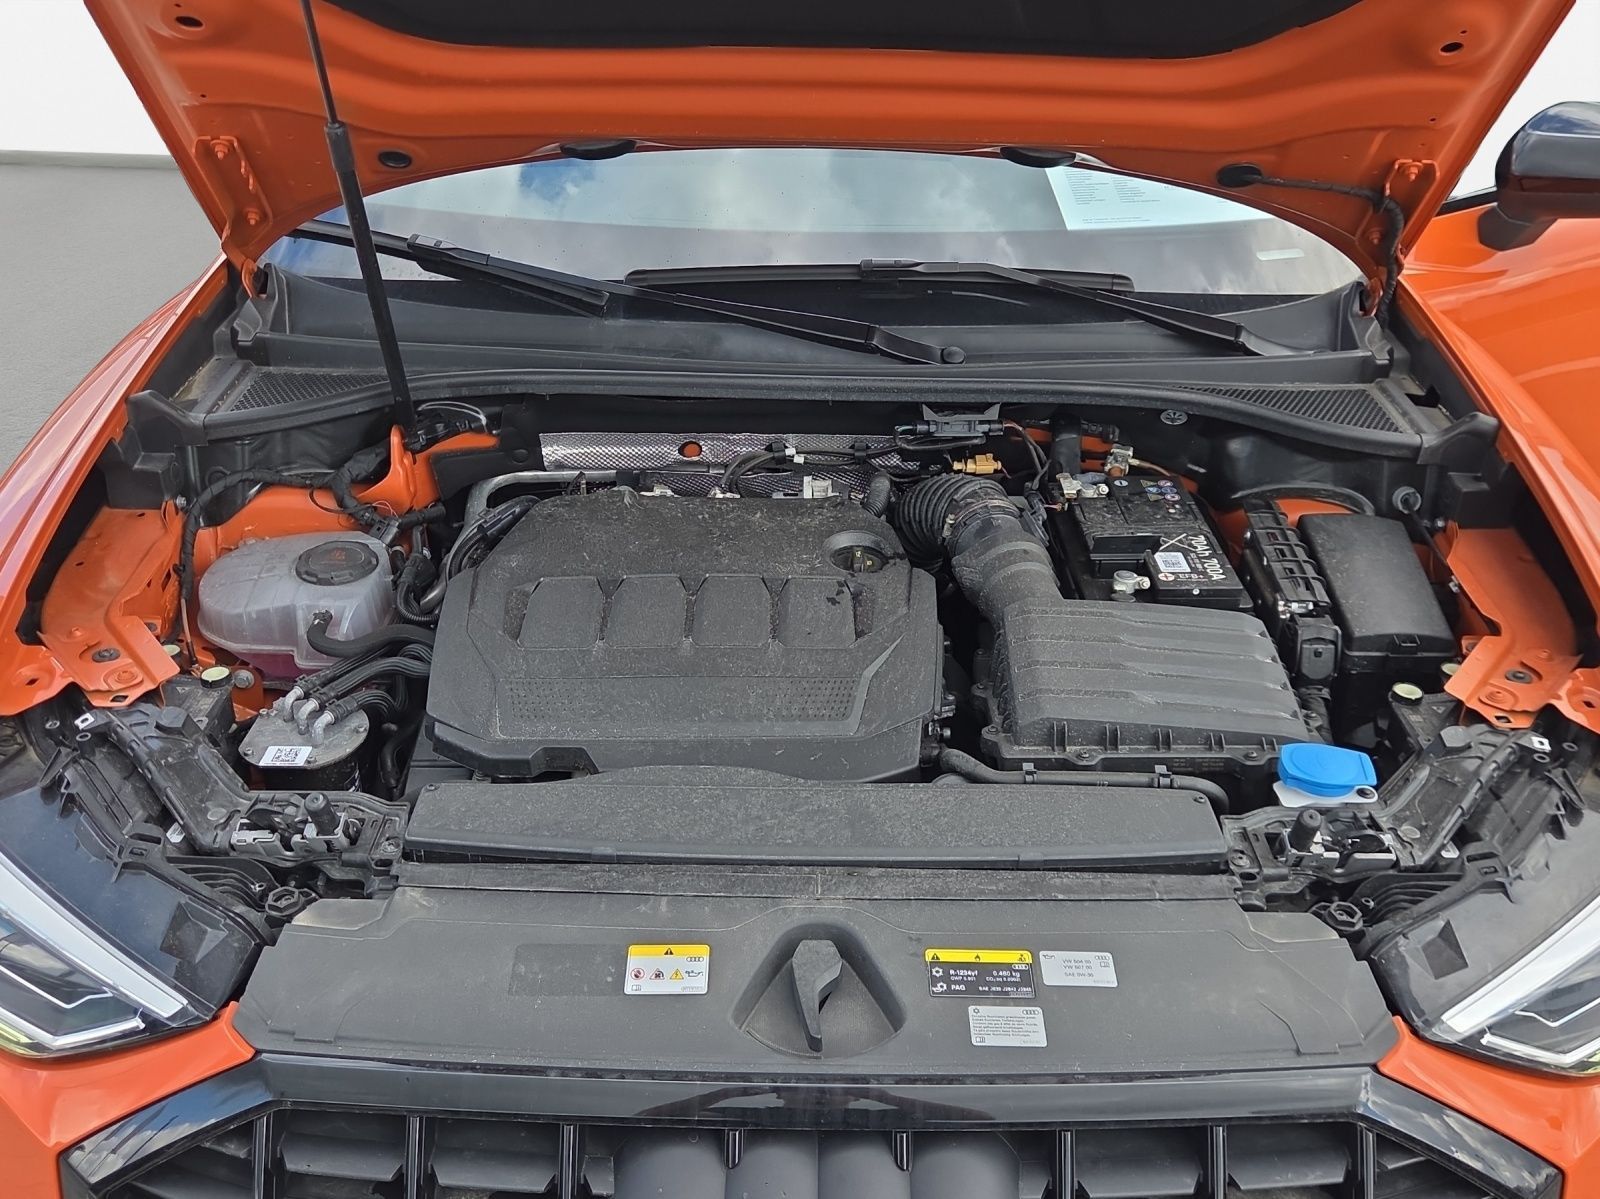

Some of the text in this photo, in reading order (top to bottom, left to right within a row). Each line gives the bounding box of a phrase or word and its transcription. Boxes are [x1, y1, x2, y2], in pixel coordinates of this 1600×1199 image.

[1188, 535, 1212, 557] 70Ah
[1201, 557, 1226, 580] 700A
[949, 969, 978, 977] R-1234yf
[1011, 969, 1021, 978] kg
